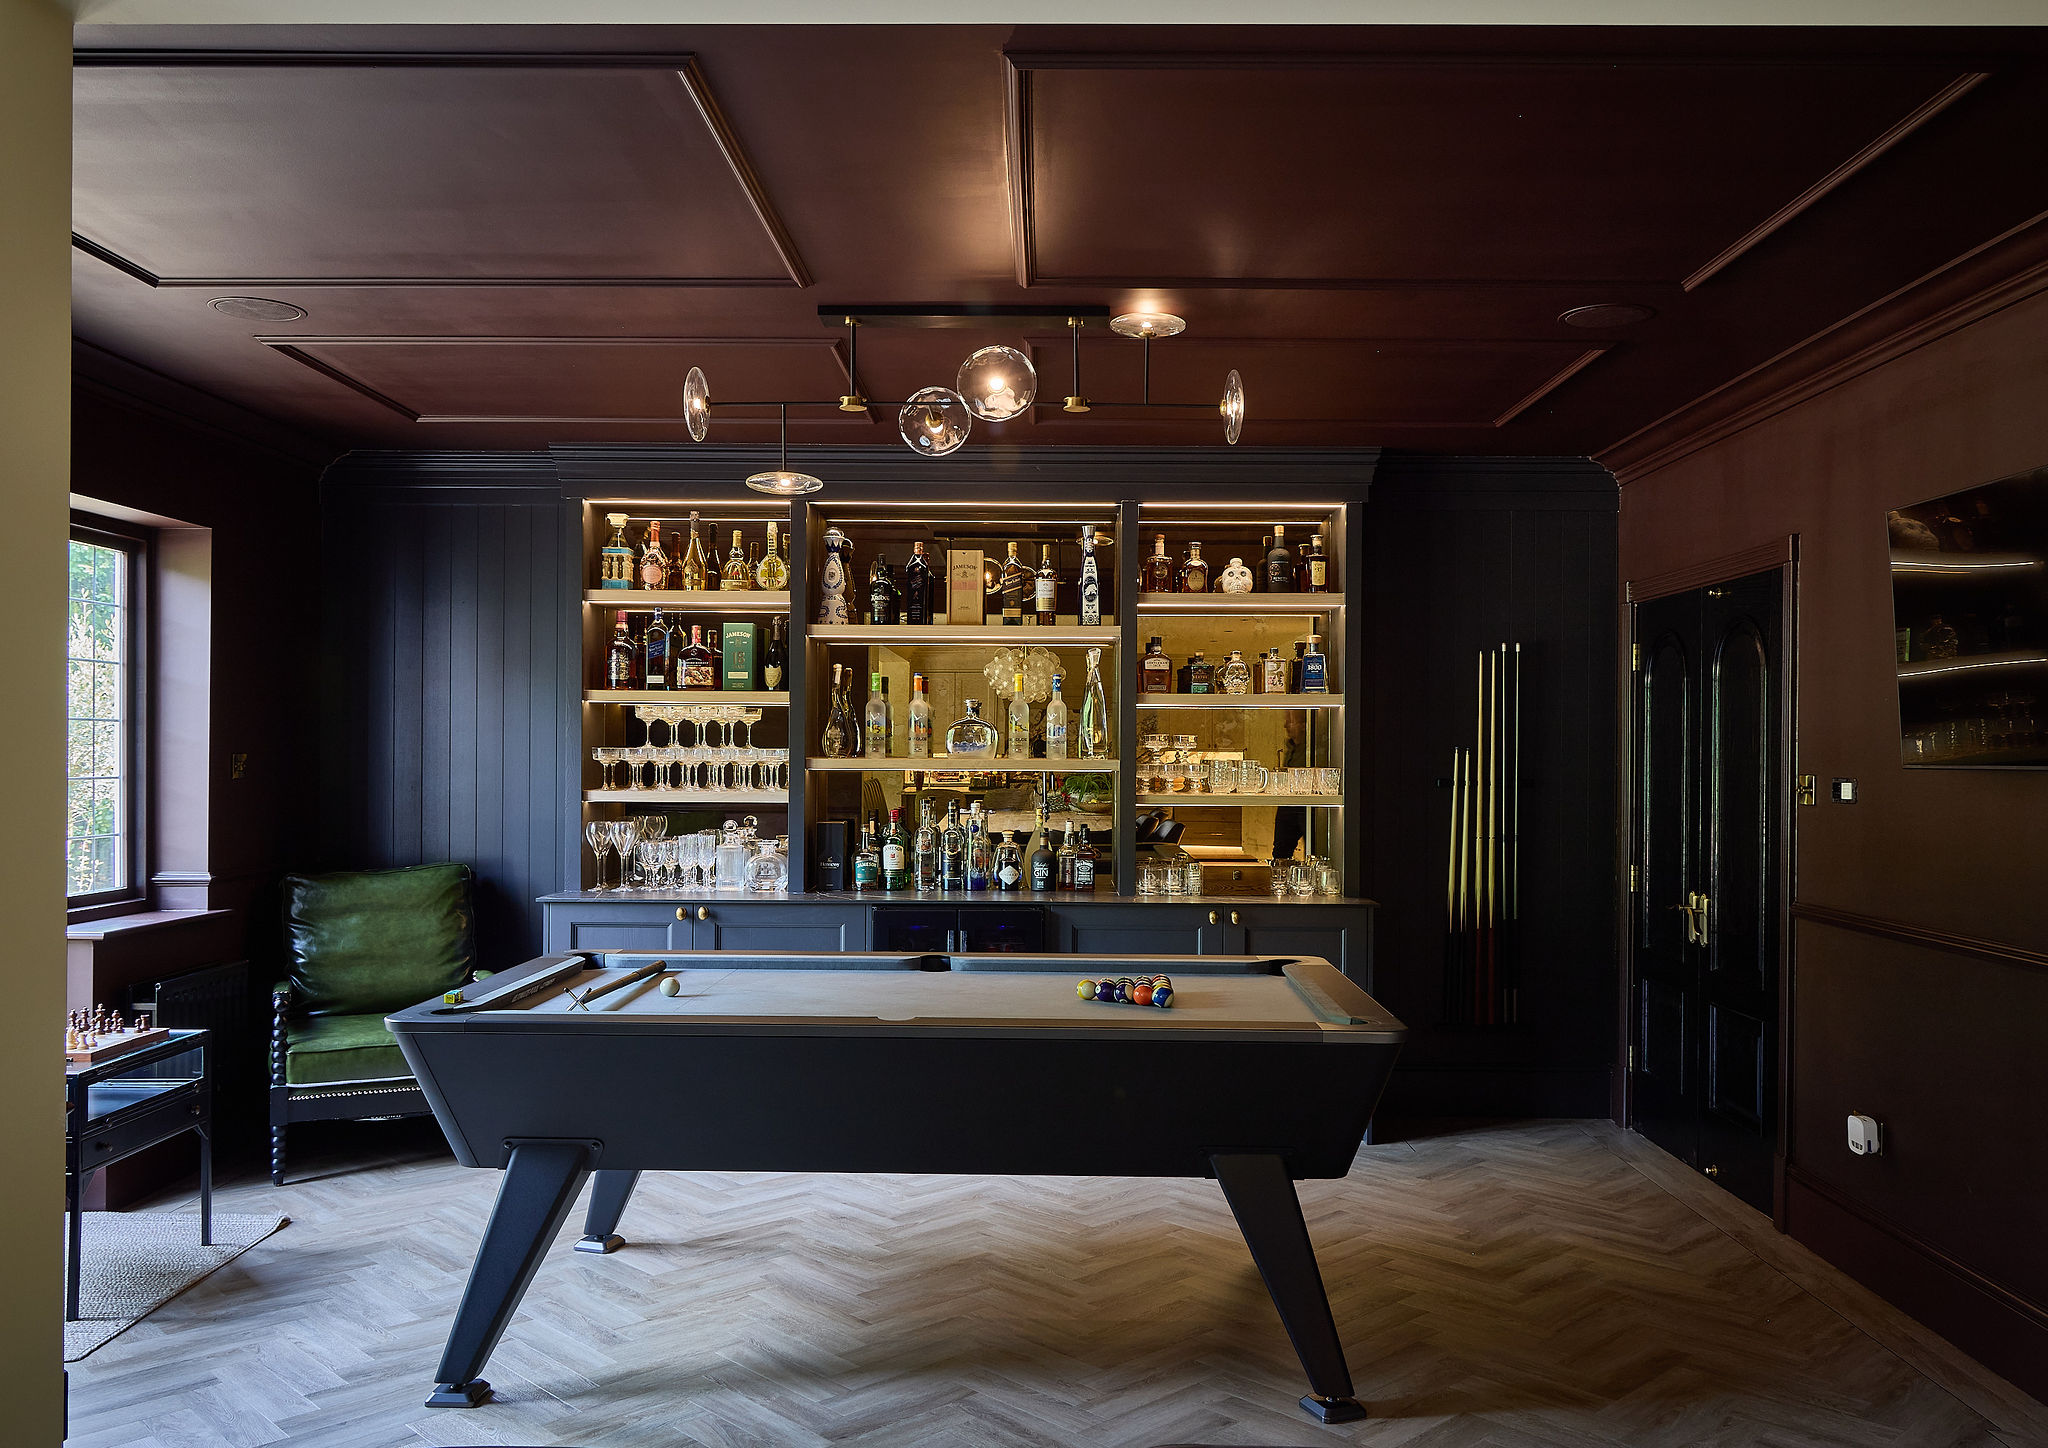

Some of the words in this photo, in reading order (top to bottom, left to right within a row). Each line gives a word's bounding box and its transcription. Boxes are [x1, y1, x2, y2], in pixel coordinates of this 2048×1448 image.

[725, 631, 752, 639] JAMESON
[732, 651, 746, 665] 18
[1033, 869, 1049, 877] GIN
